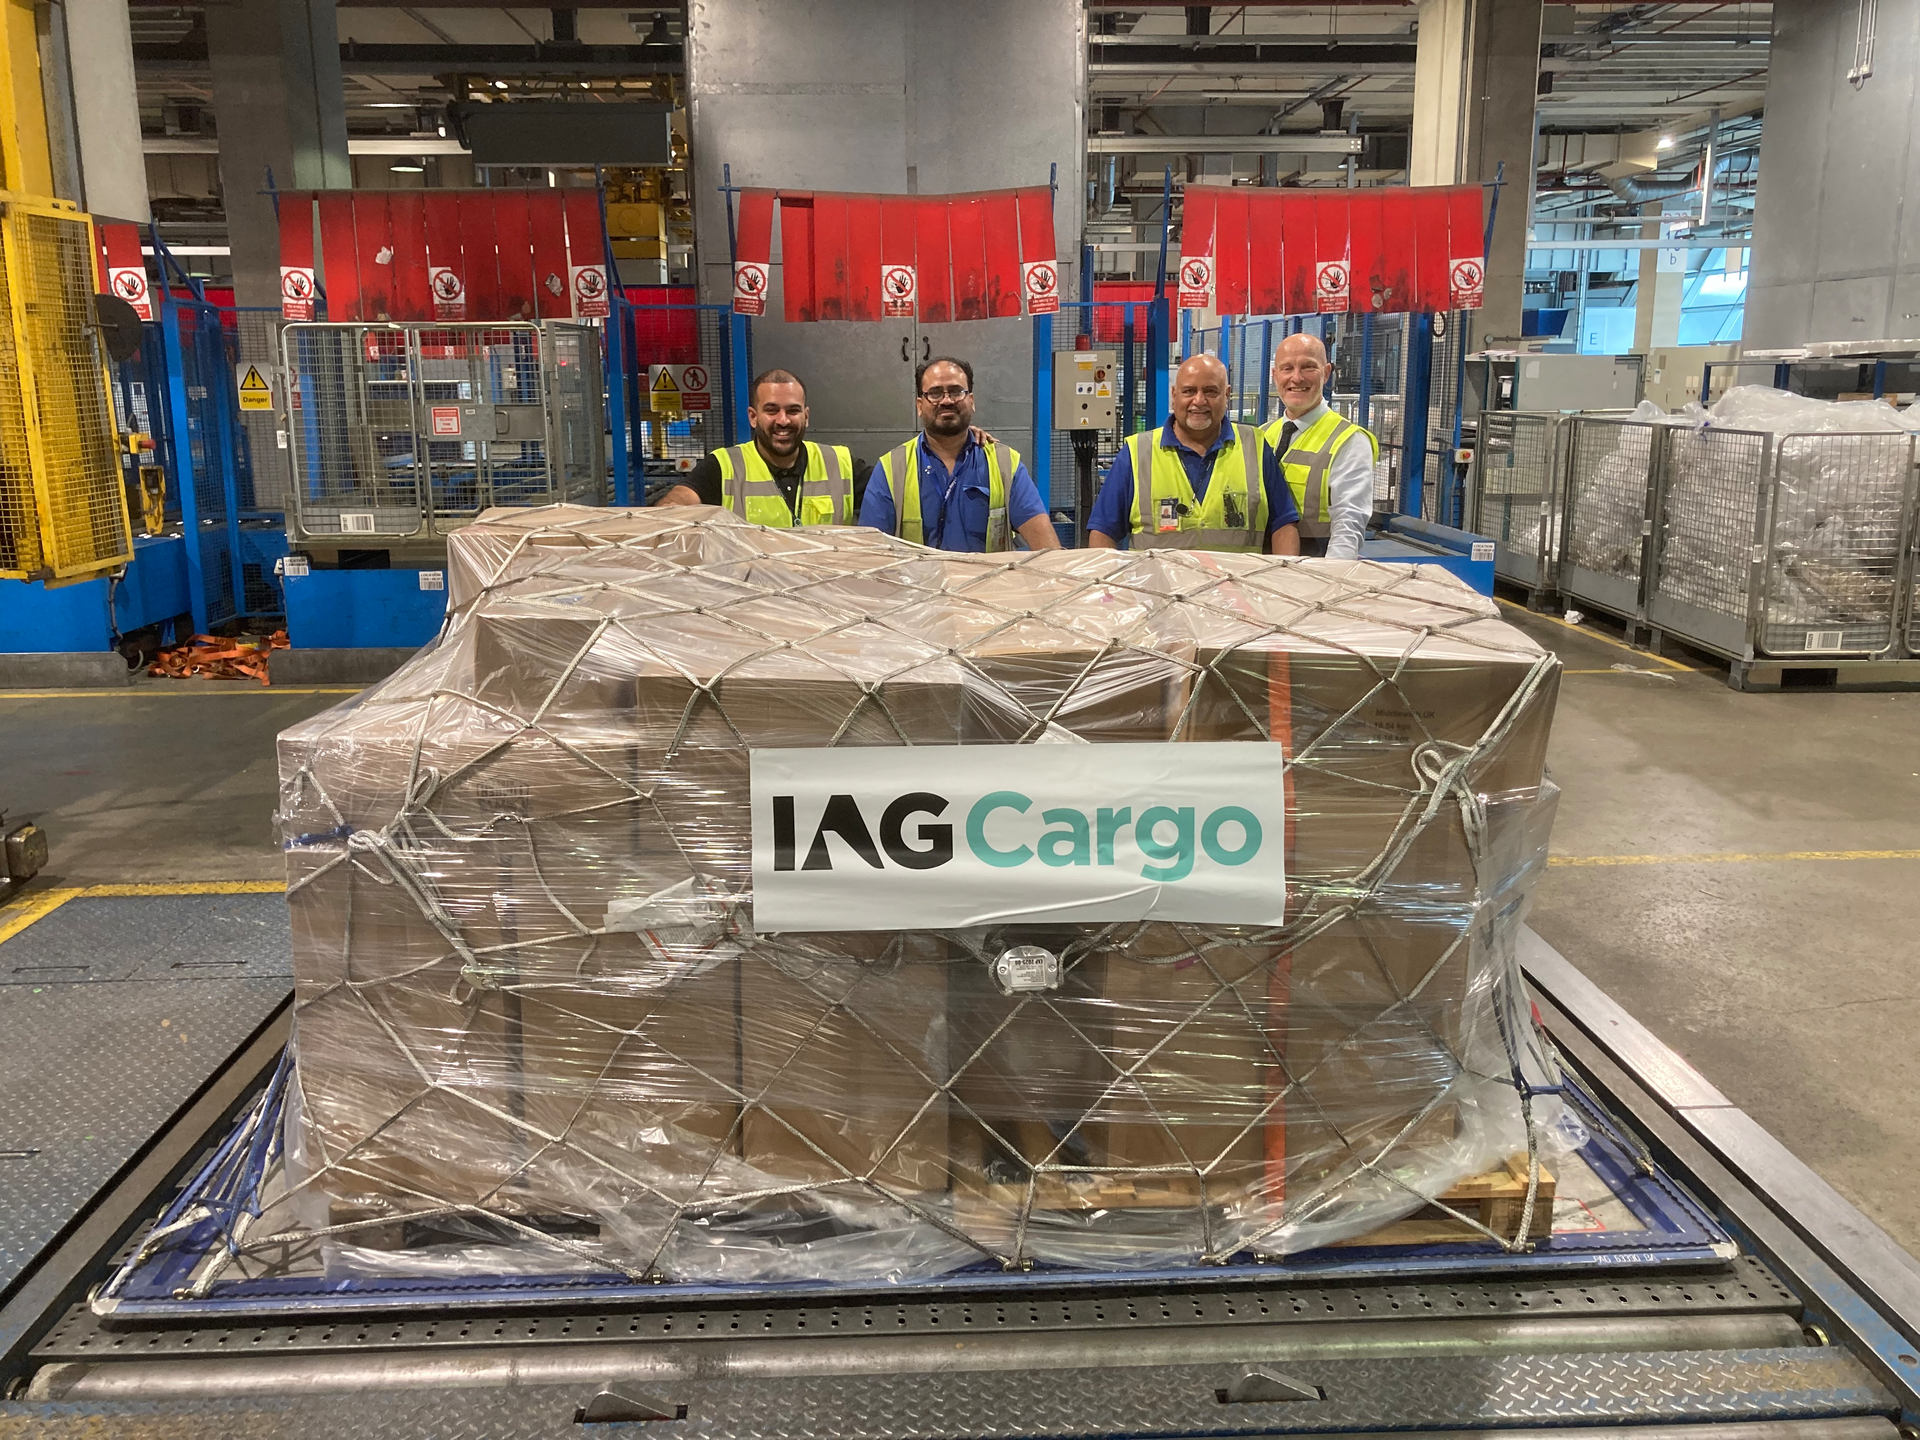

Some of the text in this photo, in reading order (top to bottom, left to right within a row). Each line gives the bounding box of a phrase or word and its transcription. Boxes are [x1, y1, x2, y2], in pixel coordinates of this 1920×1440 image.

[1669, 252, 1677, 265] b
[1589, 332, 1598, 345] E
[243, 396, 268, 404] Danger
[773, 790, 1263, 882] IAG Cargo
